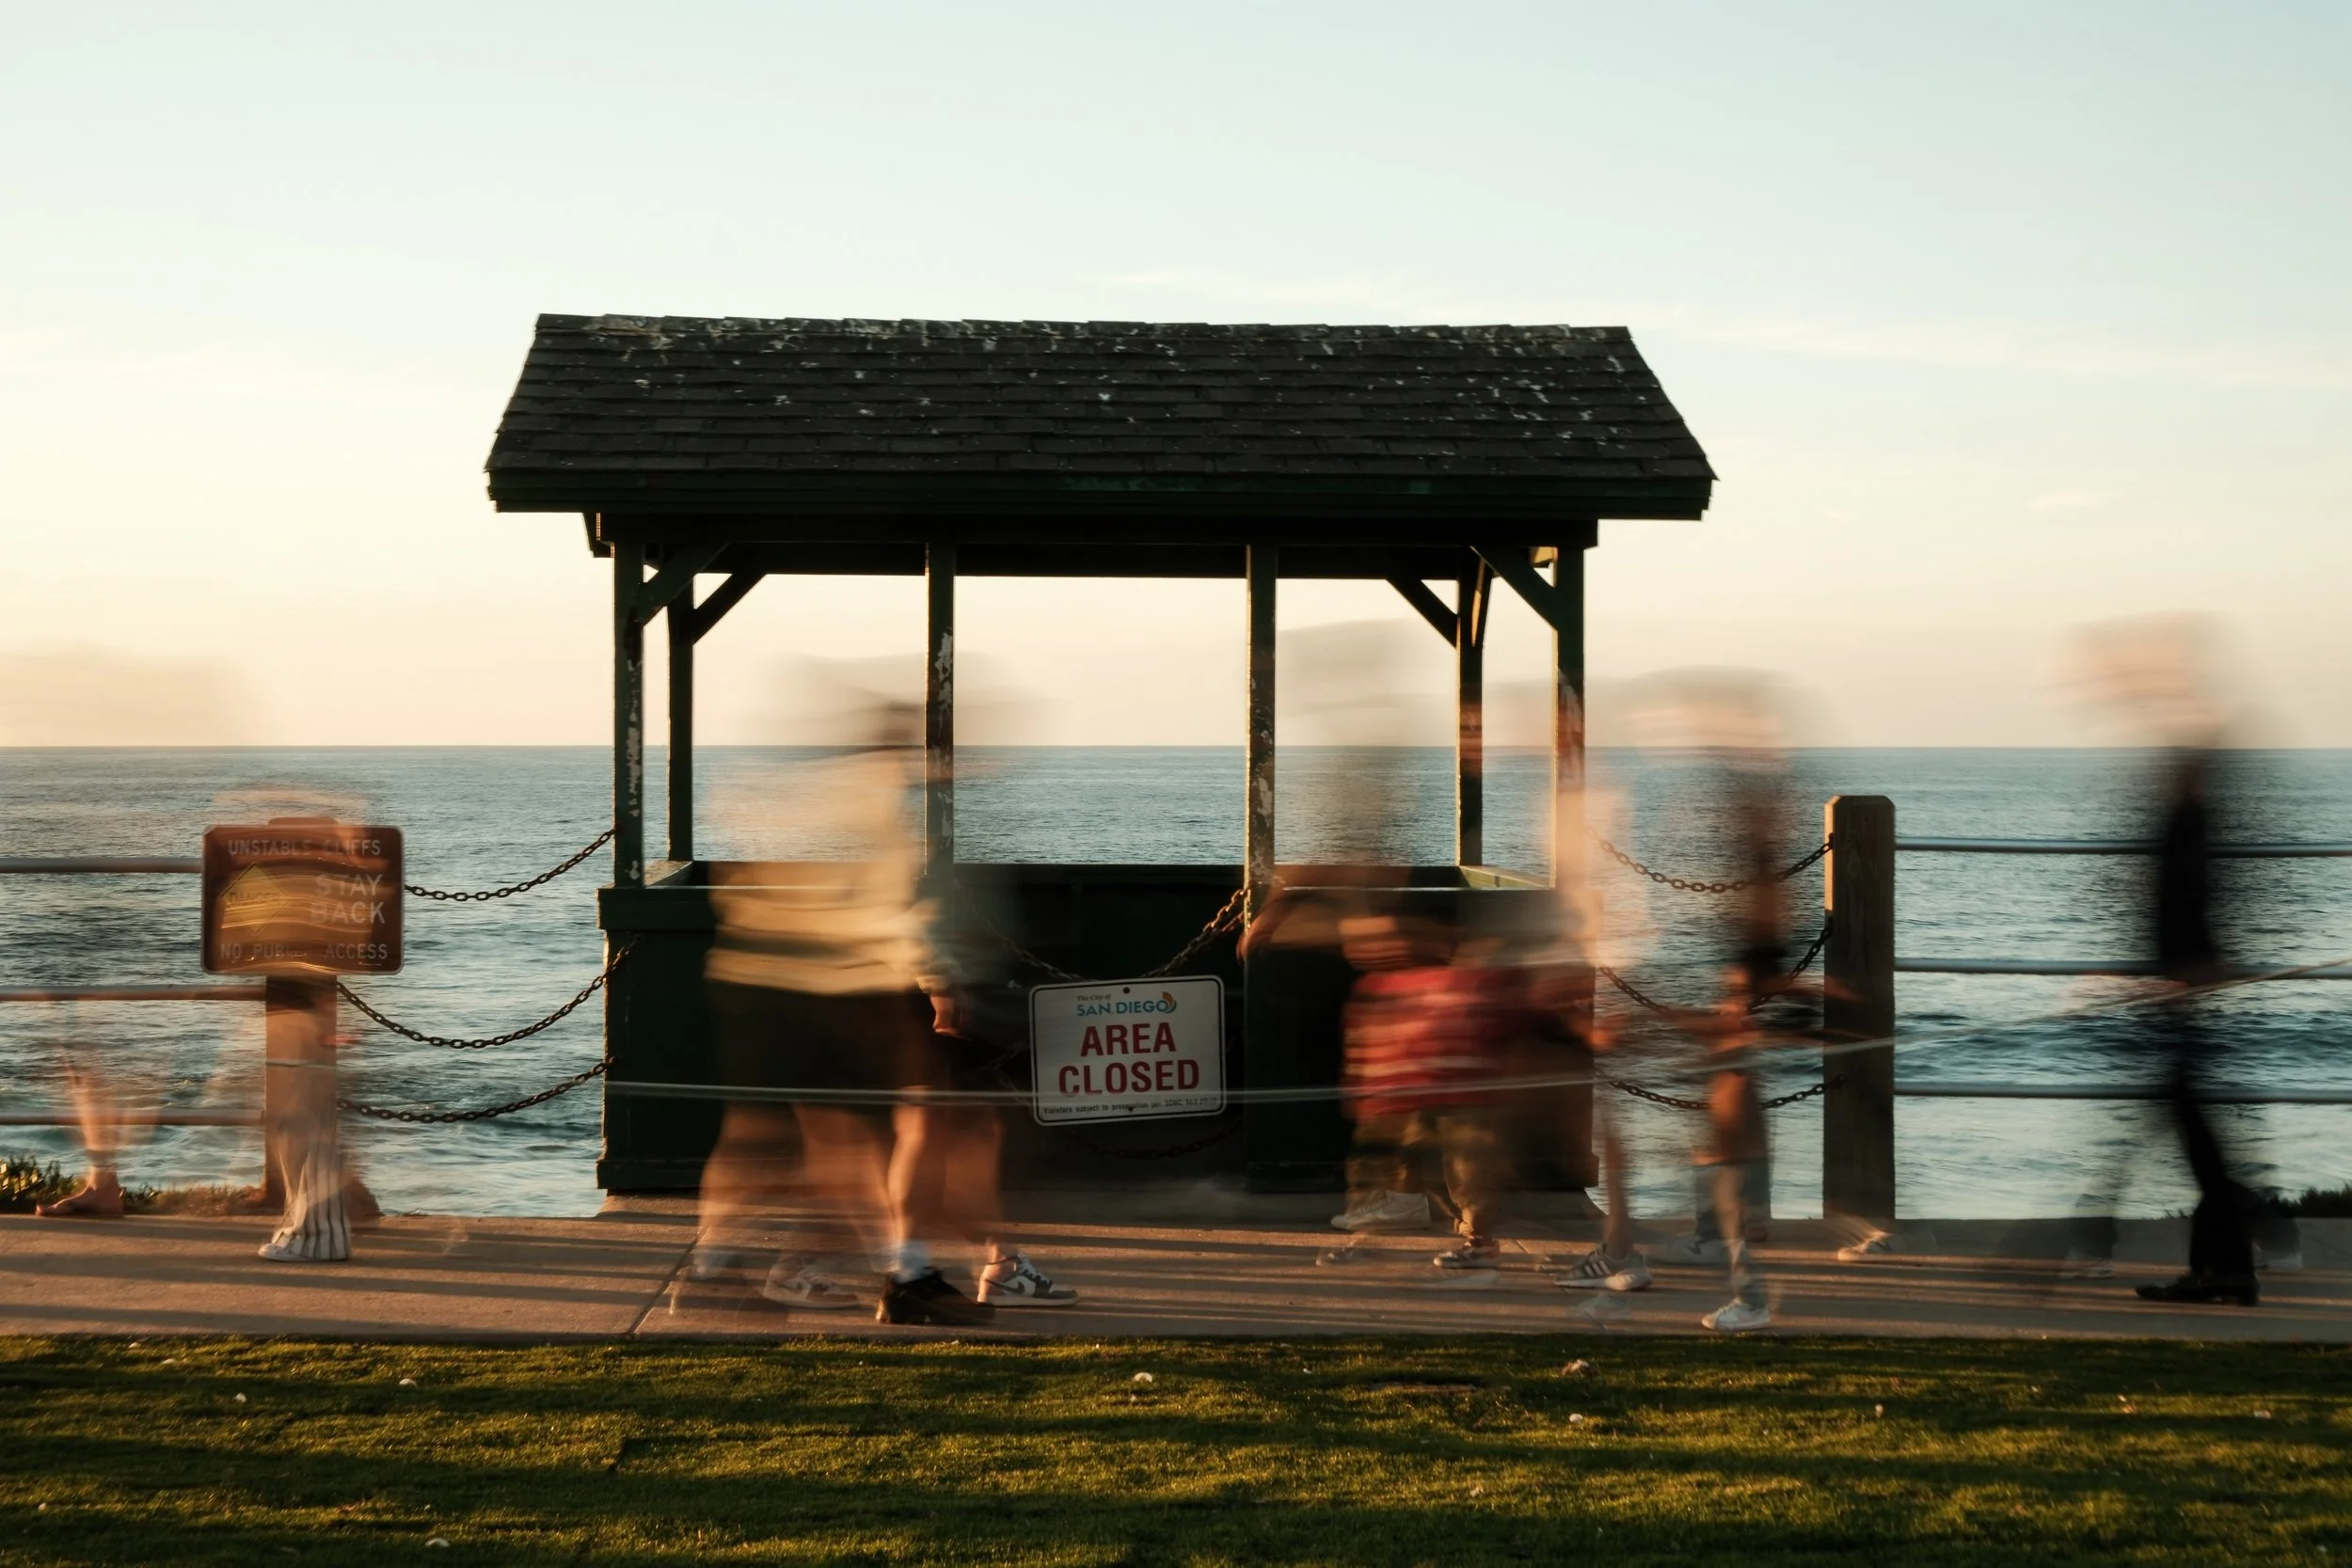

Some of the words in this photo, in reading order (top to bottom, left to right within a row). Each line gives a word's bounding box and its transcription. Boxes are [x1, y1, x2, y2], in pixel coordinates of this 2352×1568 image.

[228, 839, 311, 856] UNSTABLE
[325, 839, 381, 856] CLIFFS
[315, 873, 383, 896] STAY
[310, 901, 386, 925] BACK
[220, 943, 242, 959] NO
[325, 943, 388, 959] ACCESS
[1076, 1003, 1111, 1017] SAN
[1116, 1000, 1168, 1014] DIEGO
[1080, 1022, 1177, 1057] AREA
[1058, 1059, 1200, 1097] CLOSED
